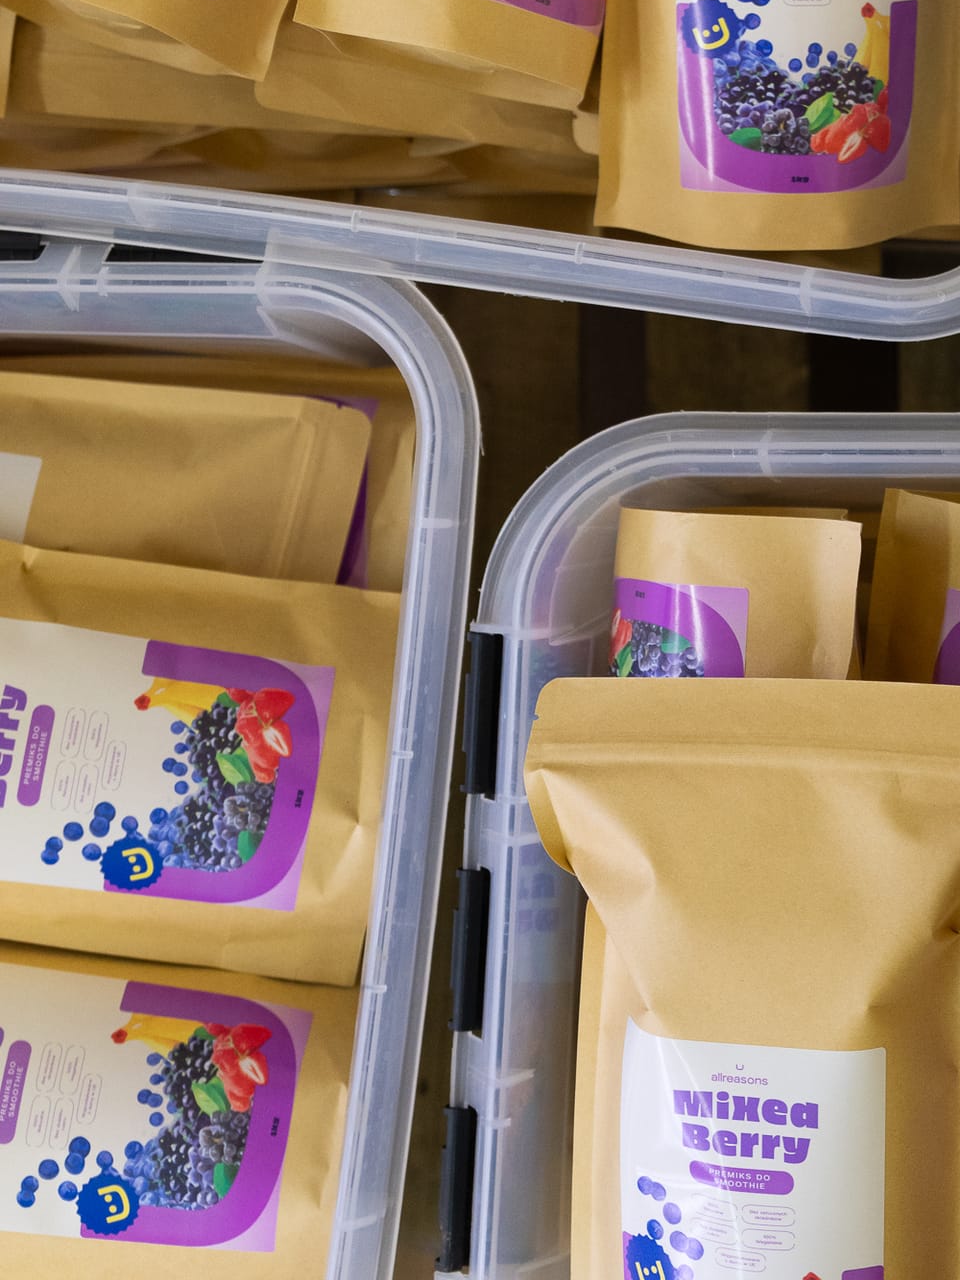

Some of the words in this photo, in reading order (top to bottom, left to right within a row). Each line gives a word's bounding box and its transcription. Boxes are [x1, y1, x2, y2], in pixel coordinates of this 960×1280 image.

[0, 684, 27, 808] erry
[24, 743, 37, 784] PREMIKS
[32, 725, 40, 740] DO
[33, 731, 48, 782] SMOOTHIE
[0, 1079, 12, 1122] PREMIKS
[8, 1061, 16, 1075] DO
[8, 1066, 23, 1118] SMOOTHIE
[711, 1072, 768, 1086] allreasons
[673, 1089, 819, 1129] Mixed
[682, 1122, 811, 1164] Berry
[708, 1168, 752, 1181] PREMIKS
[756, 1174, 771, 1182] DO
[714, 1177, 766, 1190] SMOOTHIE
